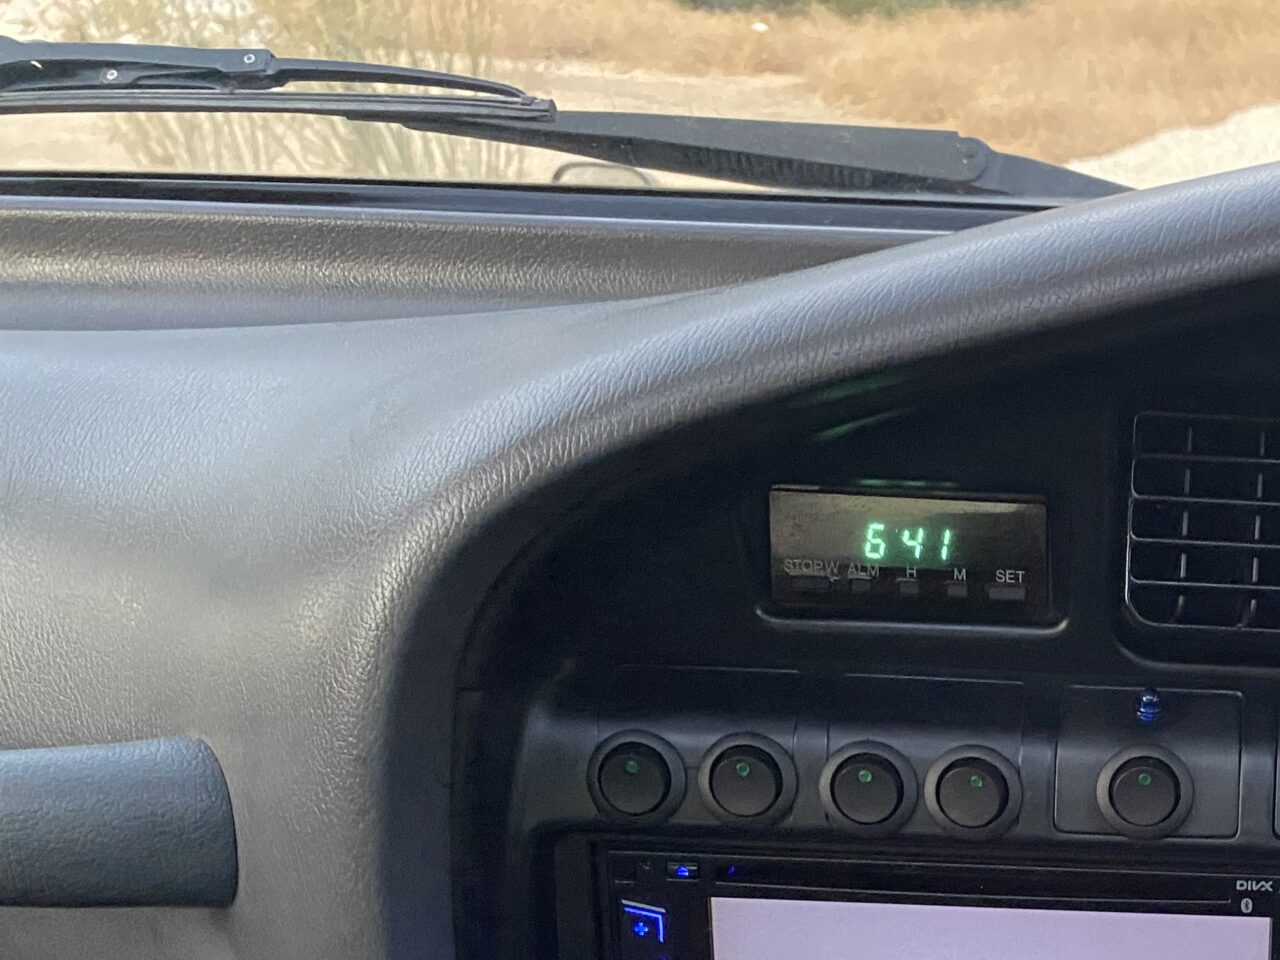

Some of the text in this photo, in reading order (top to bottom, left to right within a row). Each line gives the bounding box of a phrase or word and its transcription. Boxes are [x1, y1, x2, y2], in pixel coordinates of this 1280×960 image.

[847, 562, 879, 577] ALM
[906, 566, 917, 578] H
[953, 568, 966, 581] M
[995, 570, 1025, 583] SET
